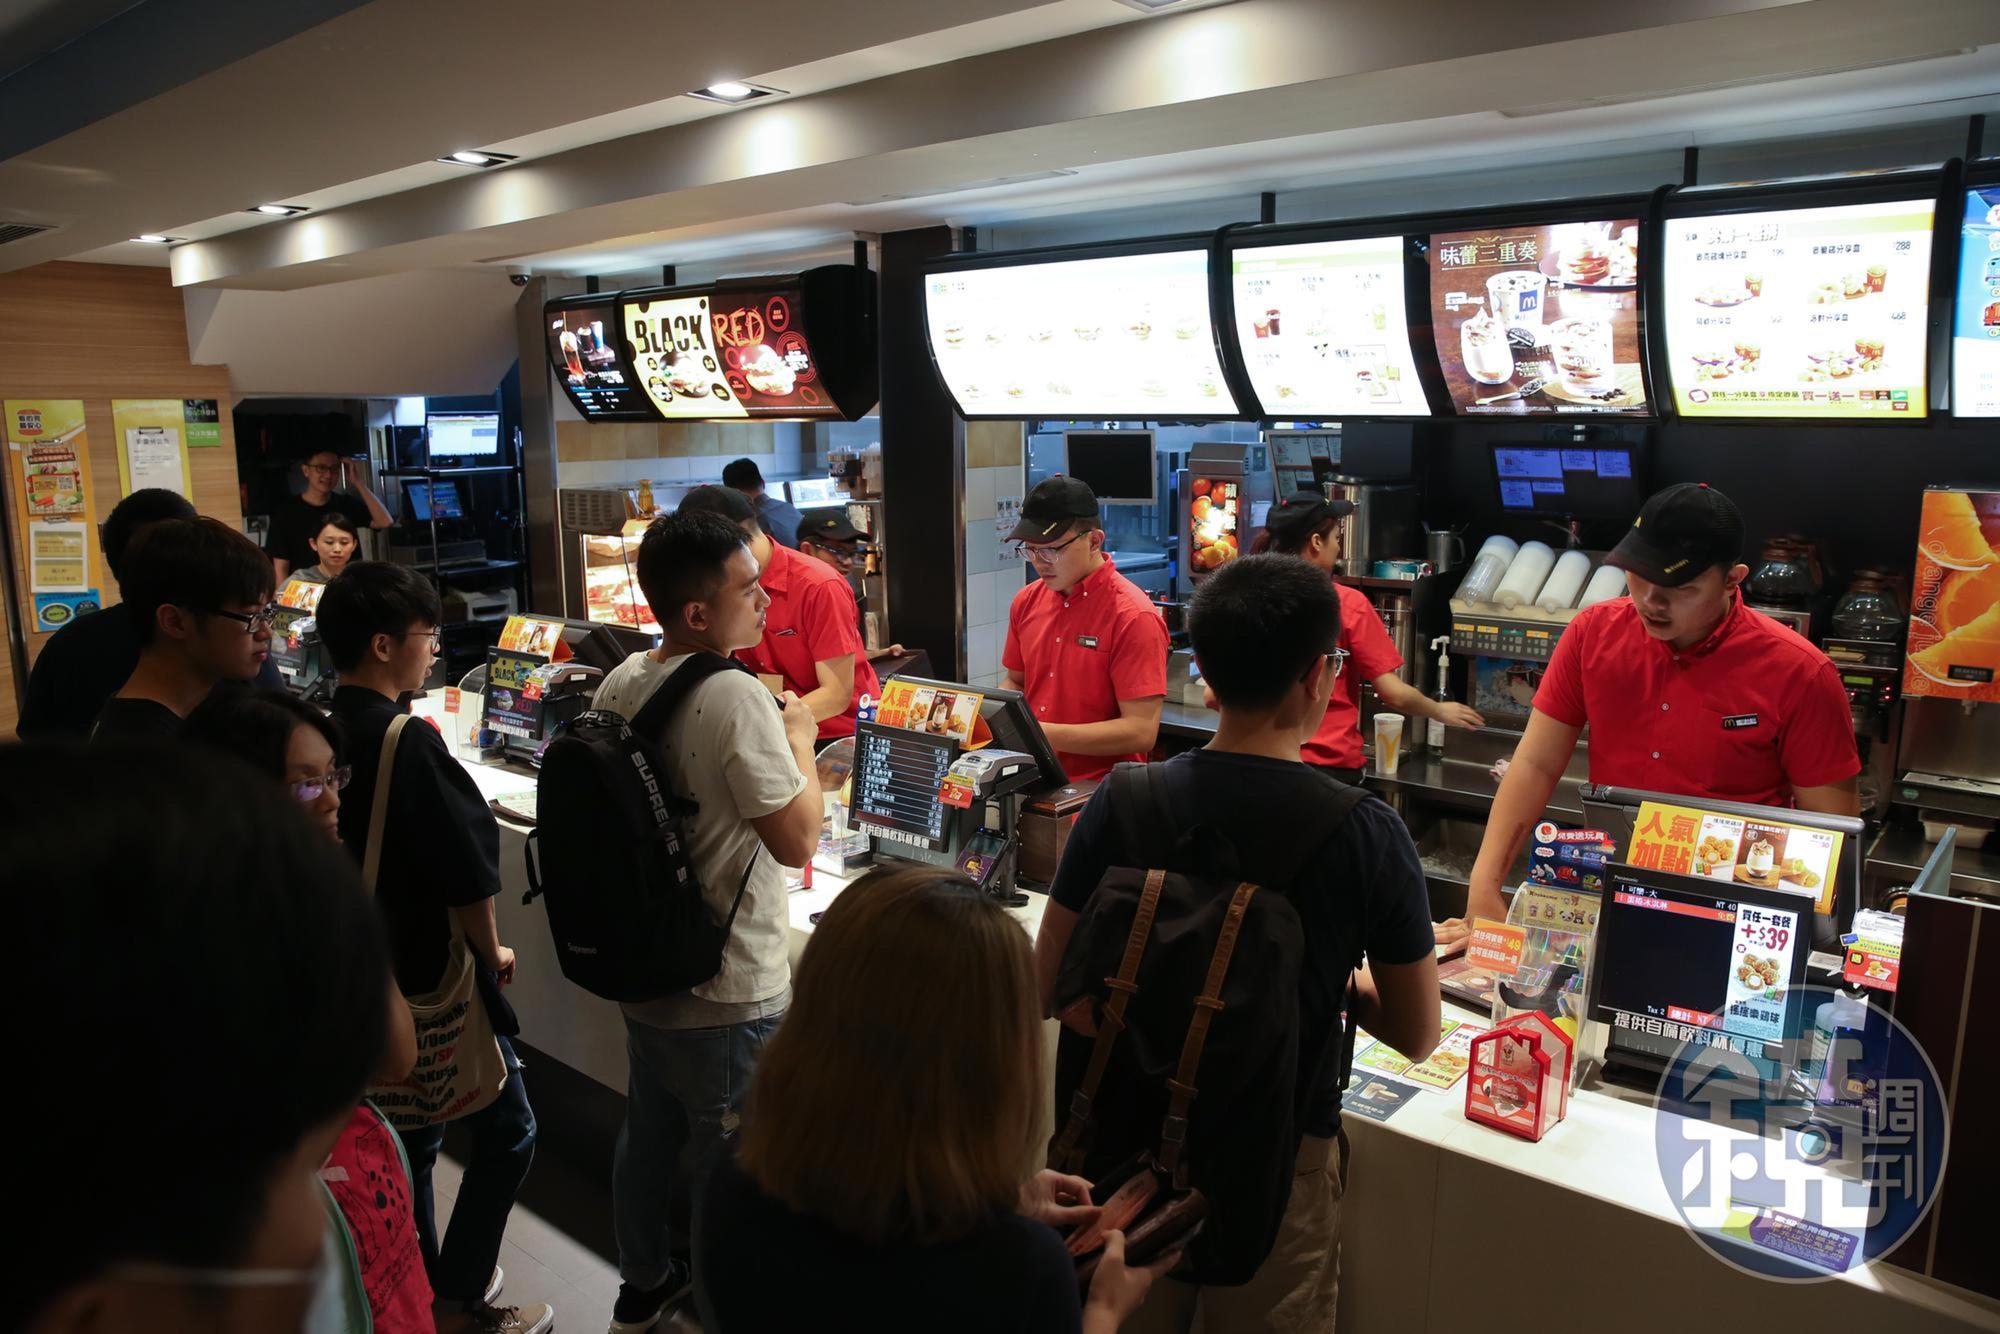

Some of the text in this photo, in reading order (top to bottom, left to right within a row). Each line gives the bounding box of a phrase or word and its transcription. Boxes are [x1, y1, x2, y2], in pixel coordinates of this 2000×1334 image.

[1440, 241, 1537, 266] 味蕾三重奏
[634, 306, 766, 354] BLACK RED
[495, 667, 516, 682] BLACK
[883, 686, 913, 708] 人氣
[1640, 811, 1698, 844] 人氣
[1632, 839, 1691, 874] 加點
[1727, 903, 1737, 911] 40
[1742, 909, 1792, 929] 買任一套餐
[1647, 1004, 1659, 1014] Tax
[1659, 1008, 1665, 1016] 2
[1614, 1011, 1763, 1059] 提供自備飲料杯優惠
